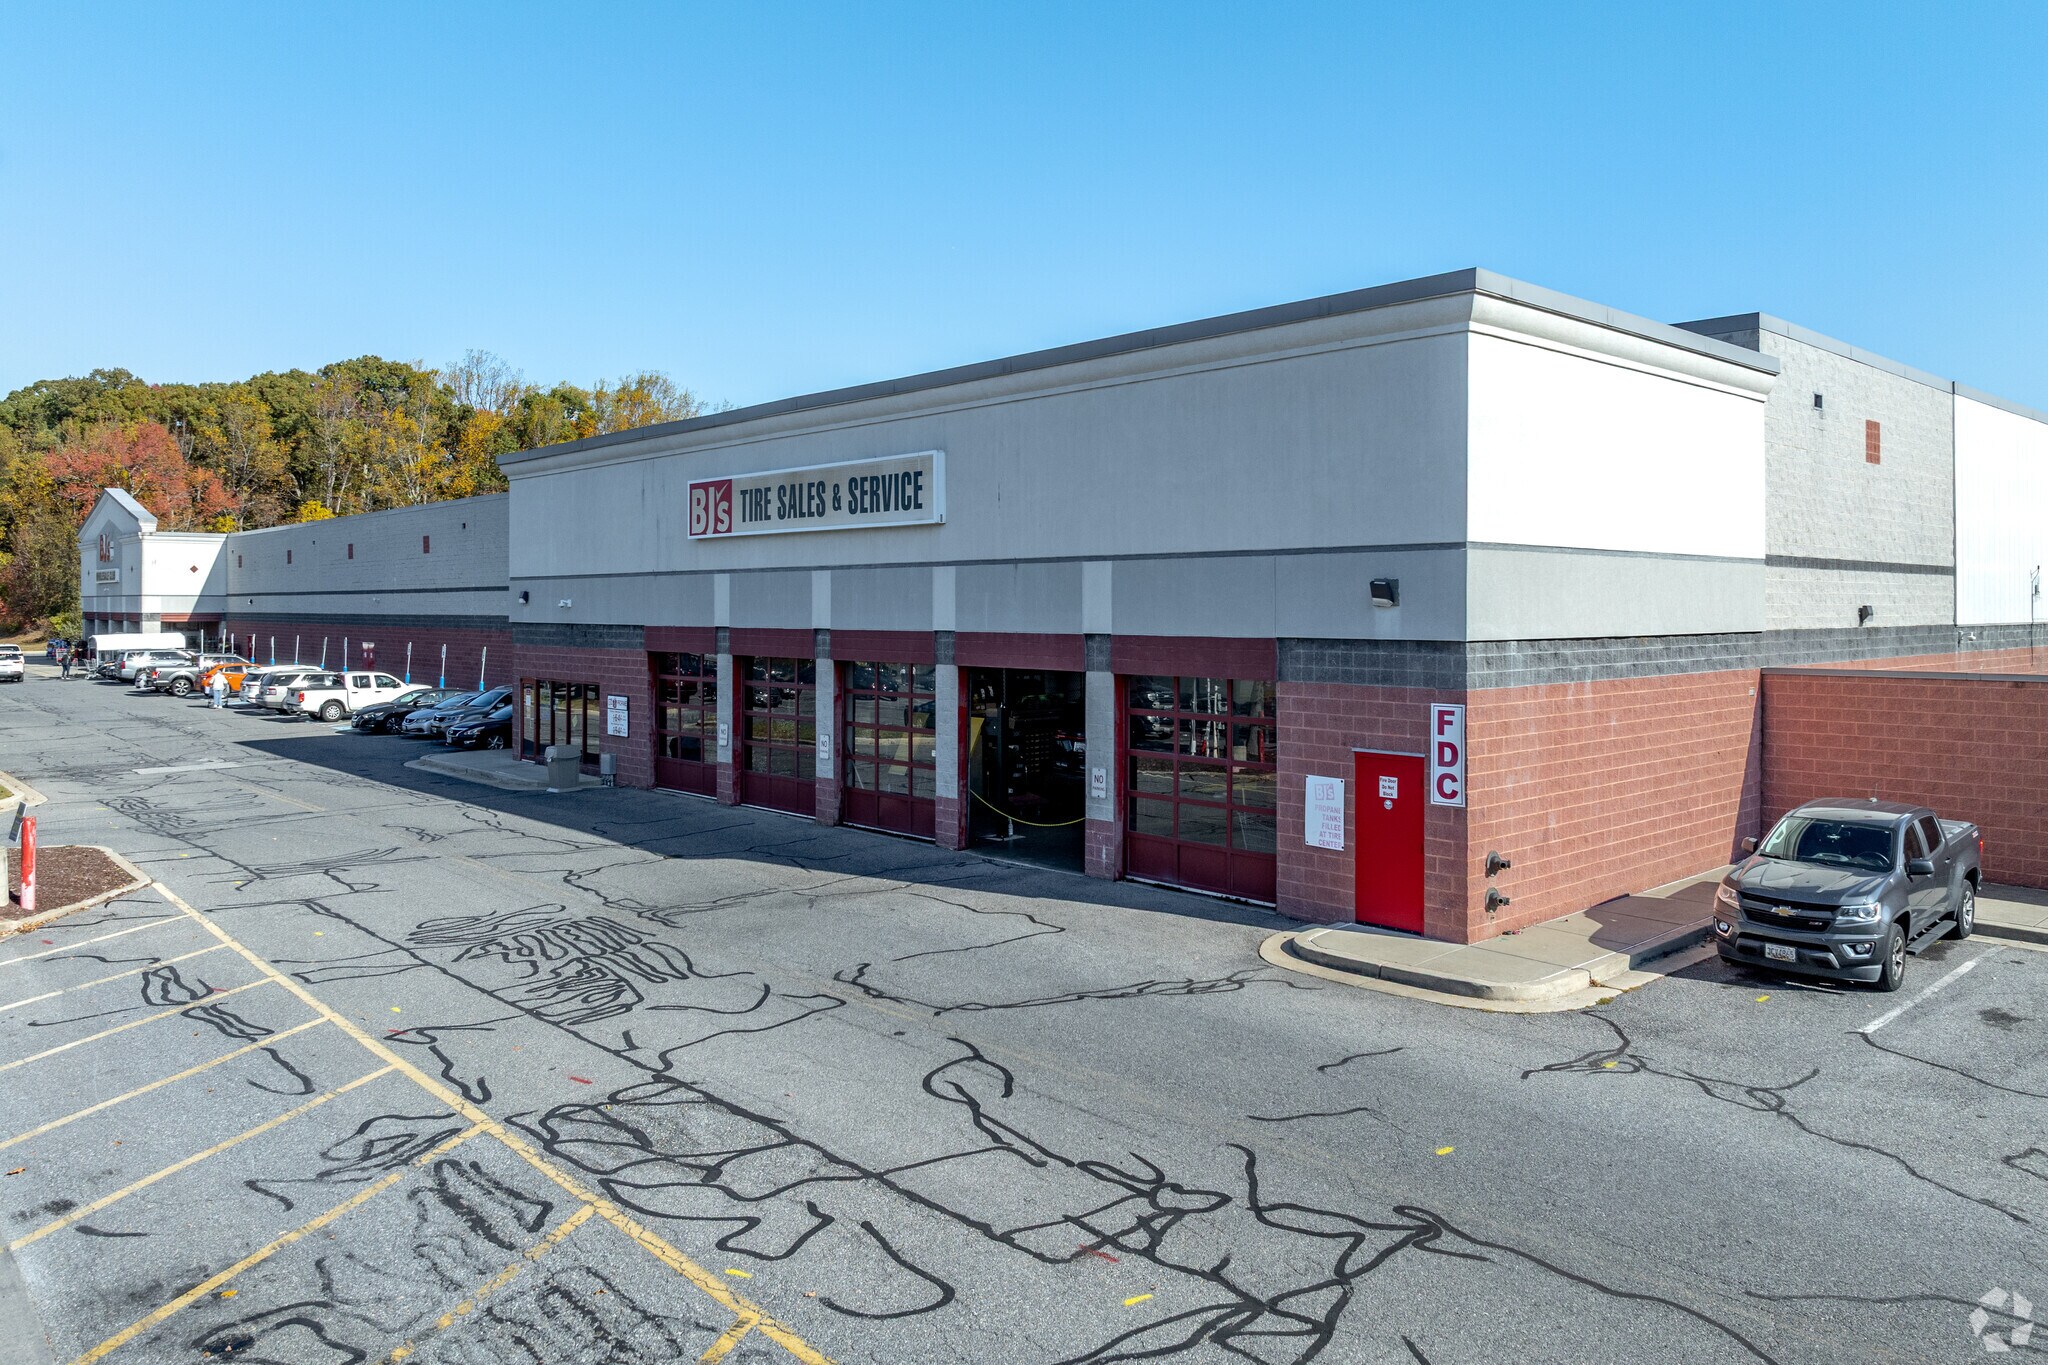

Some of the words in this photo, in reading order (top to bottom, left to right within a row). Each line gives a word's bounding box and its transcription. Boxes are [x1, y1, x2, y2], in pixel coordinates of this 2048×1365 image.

[691, 481, 730, 535] BJ's
[740, 489, 771, 523] TIRE
[777, 481, 826, 521] SALES
[832, 483, 842, 512] &
[848, 471, 923, 515] SERVICE
[1093, 774, 1104, 784] NO
[1315, 783, 1335, 801] BJ's
[1315, 804, 1341, 814] PROPANE
[1322, 814, 1342, 823] TANKS
[1321, 823, 1342, 832] FILLED
[1328, 831, 1342, 841] TIRE
[1318, 839, 1342, 849] CENTER
